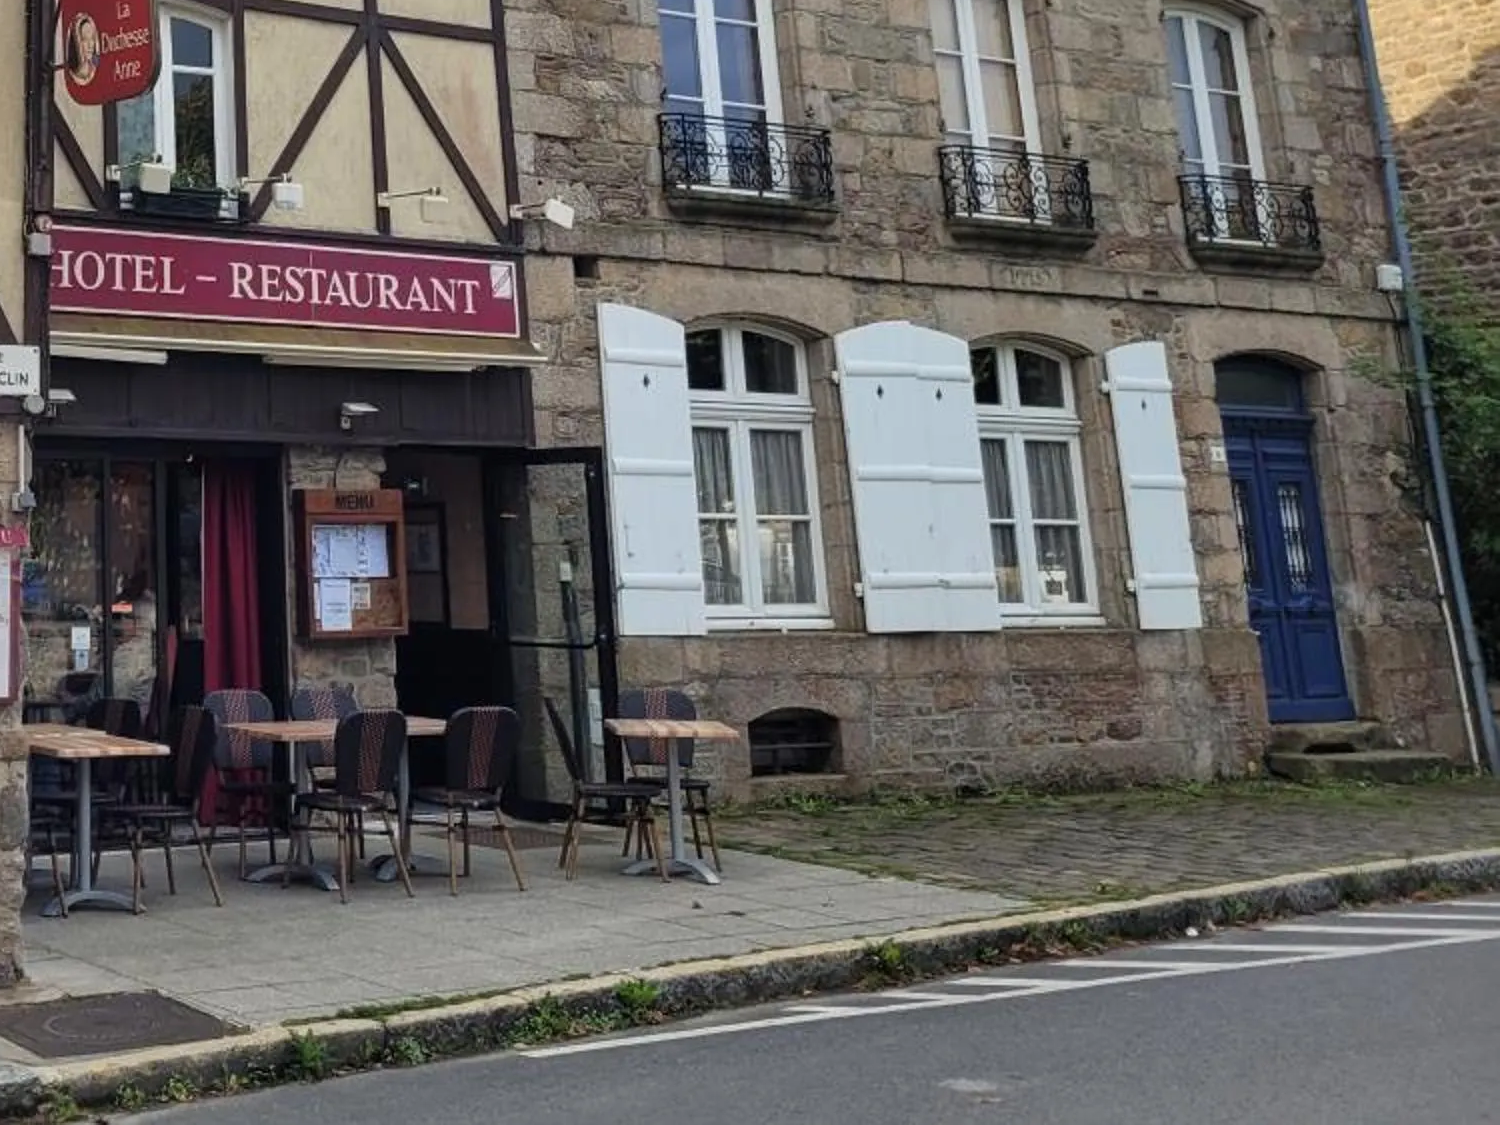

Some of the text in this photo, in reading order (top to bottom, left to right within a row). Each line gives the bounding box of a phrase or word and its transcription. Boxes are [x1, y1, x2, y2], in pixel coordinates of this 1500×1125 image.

[116, 2, 131, 21] La
[101, 27, 150, 54] Duchesse
[114, 59, 141, 80] Anne
[52, 250, 186, 295] HOTEL
[228, 261, 481, 315] RESTAURANT
